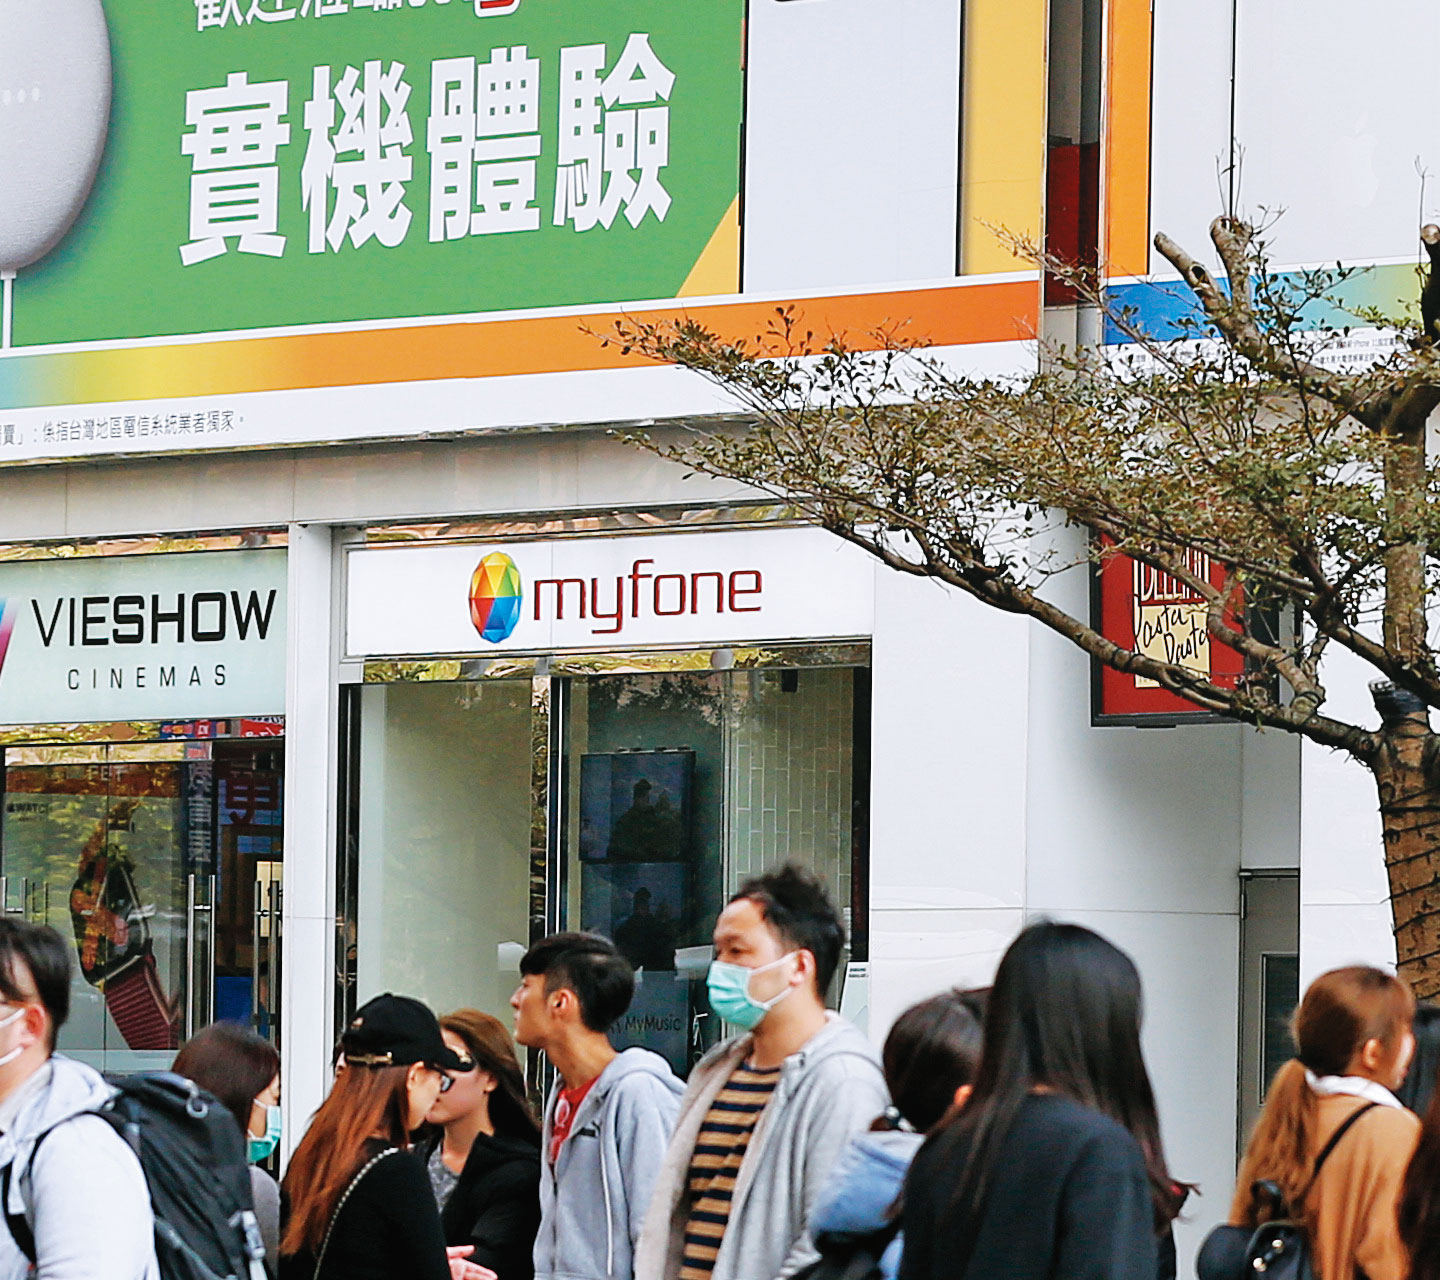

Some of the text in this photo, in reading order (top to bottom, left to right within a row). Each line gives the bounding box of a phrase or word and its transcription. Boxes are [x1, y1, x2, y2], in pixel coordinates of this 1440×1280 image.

[177, 32, 677, 268] 實機體驗
[31, 589, 277, 648] VIESHOW
[533, 558, 763, 635] myfone
[66, 664, 227, 692] CINEMAS
